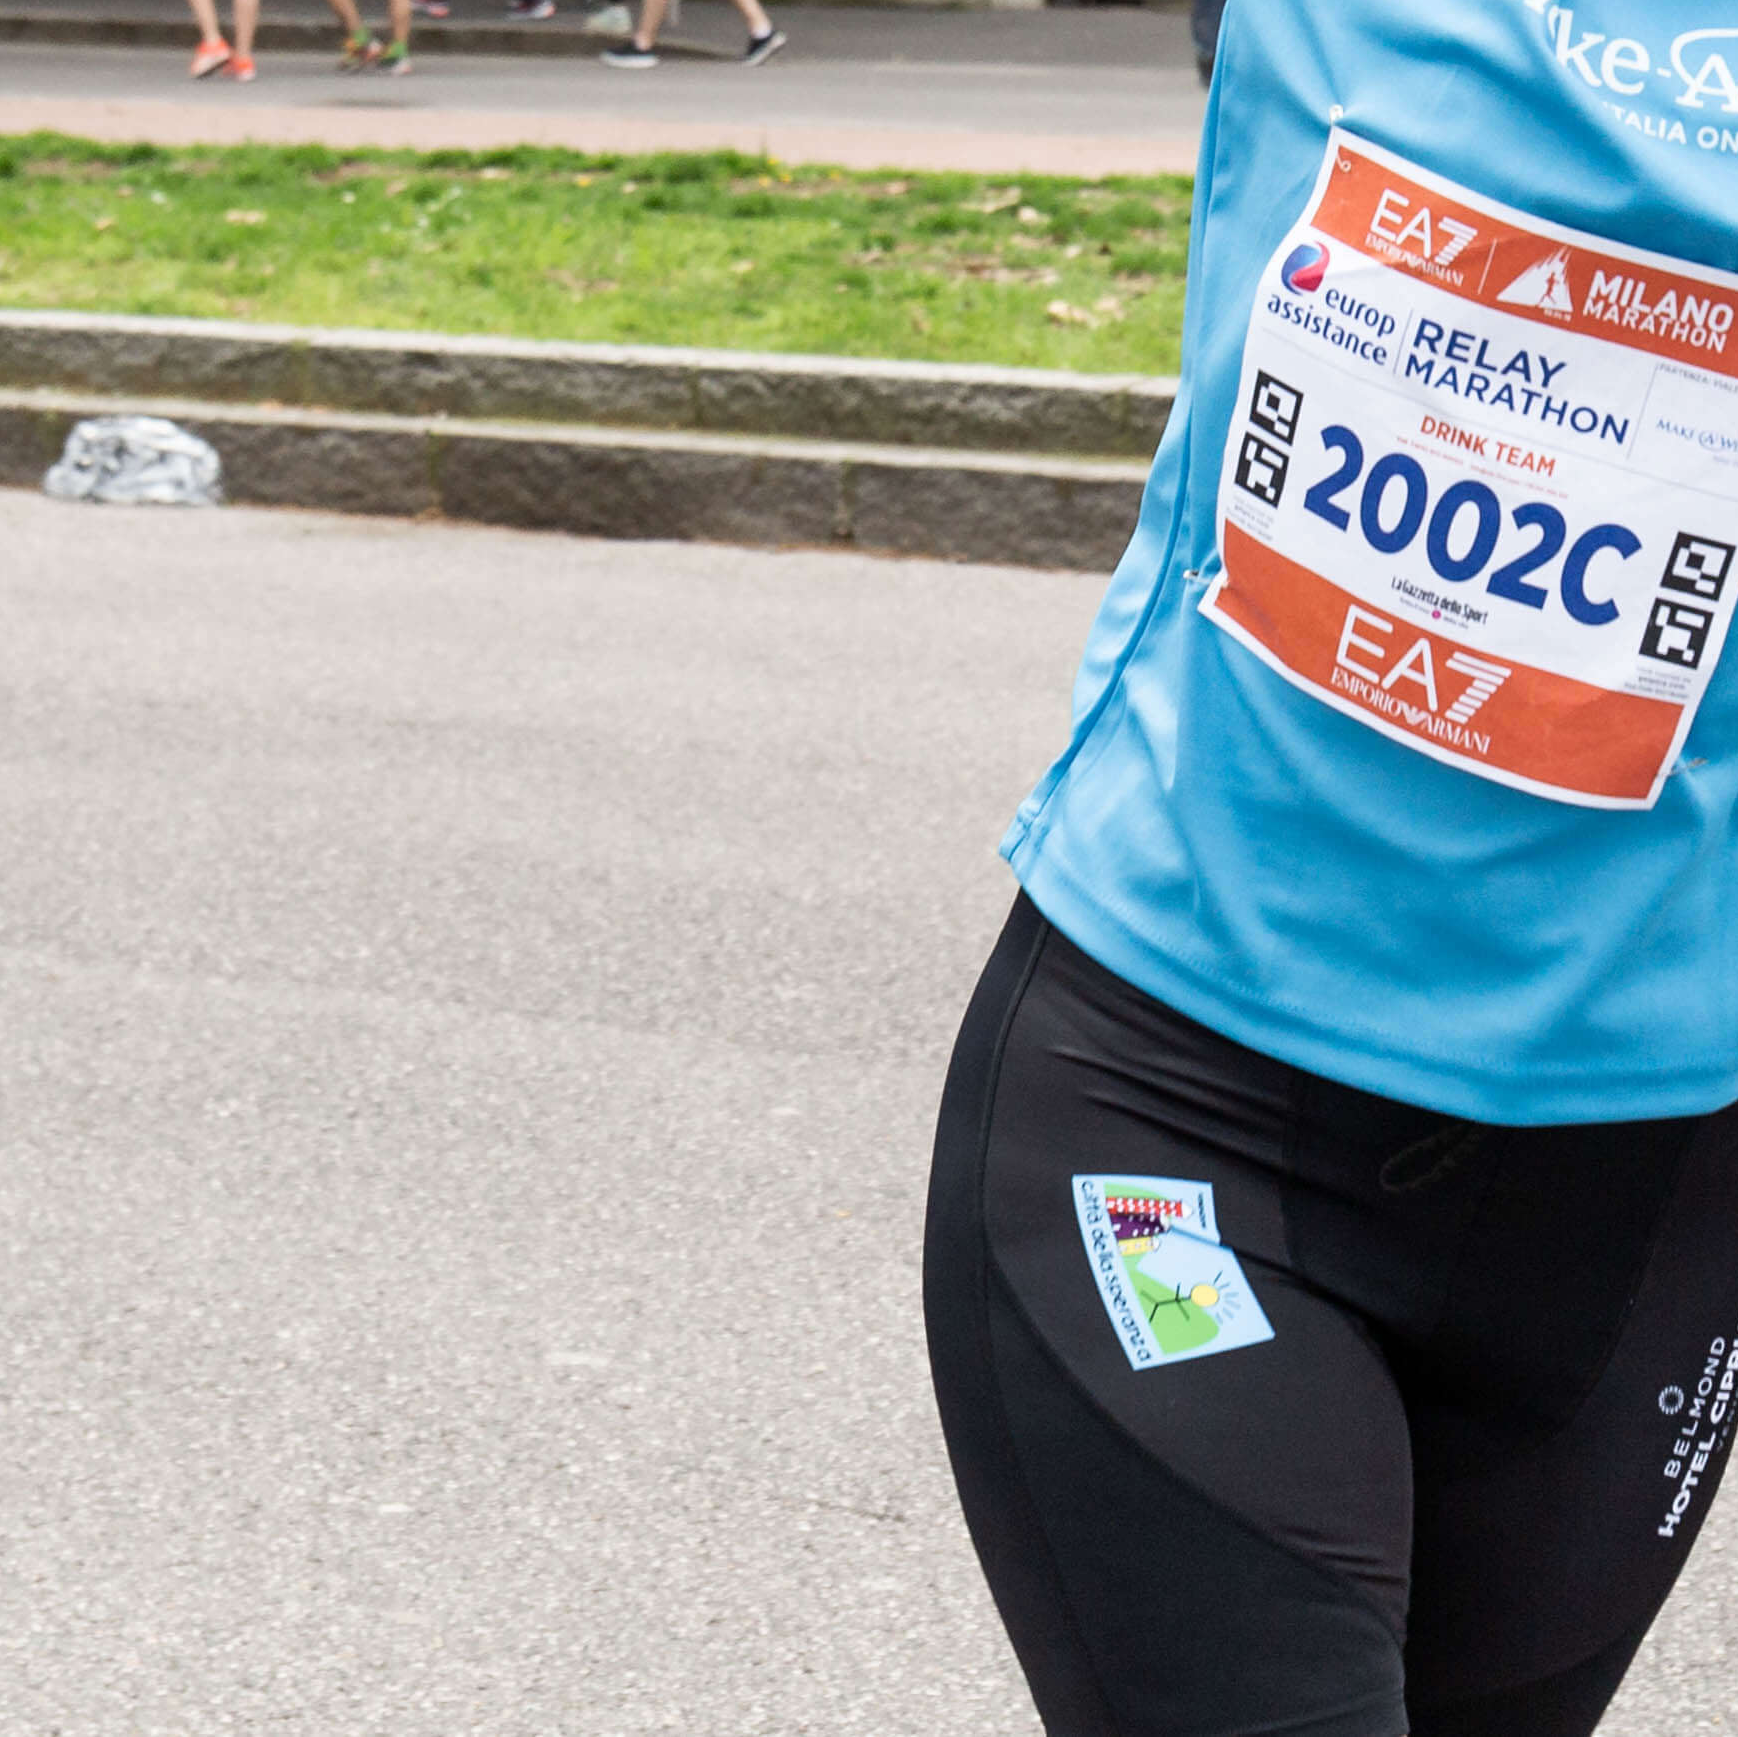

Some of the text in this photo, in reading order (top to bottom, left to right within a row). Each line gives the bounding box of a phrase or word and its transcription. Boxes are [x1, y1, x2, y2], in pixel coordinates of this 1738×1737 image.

[1602, 101, 1687, 145] TALIA
[1369, 188, 1478, 267] EA7
[1267, 292, 1388, 366] assistance
[1325, 286, 1396, 337] europ
[1582, 299, 1727, 354] MARATHON
[1587, 270, 1734, 333] MILANO
[1411, 317, 1568, 389] RELAY
[1404, 353, 1630, 445] MARATHON
[1419, 415, 1488, 457] DRINK
[1494, 441, 1557, 478] TEAM
[1303, 424, 1642, 627] 2002C
[1336, 603, 1512, 725] EA7
[1331, 666, 1491, 754] EMPORIO ARMANI
[1663, 1335, 1726, 1479] BELMOND
[1657, 1431, 1717, 1538] HOTEL
